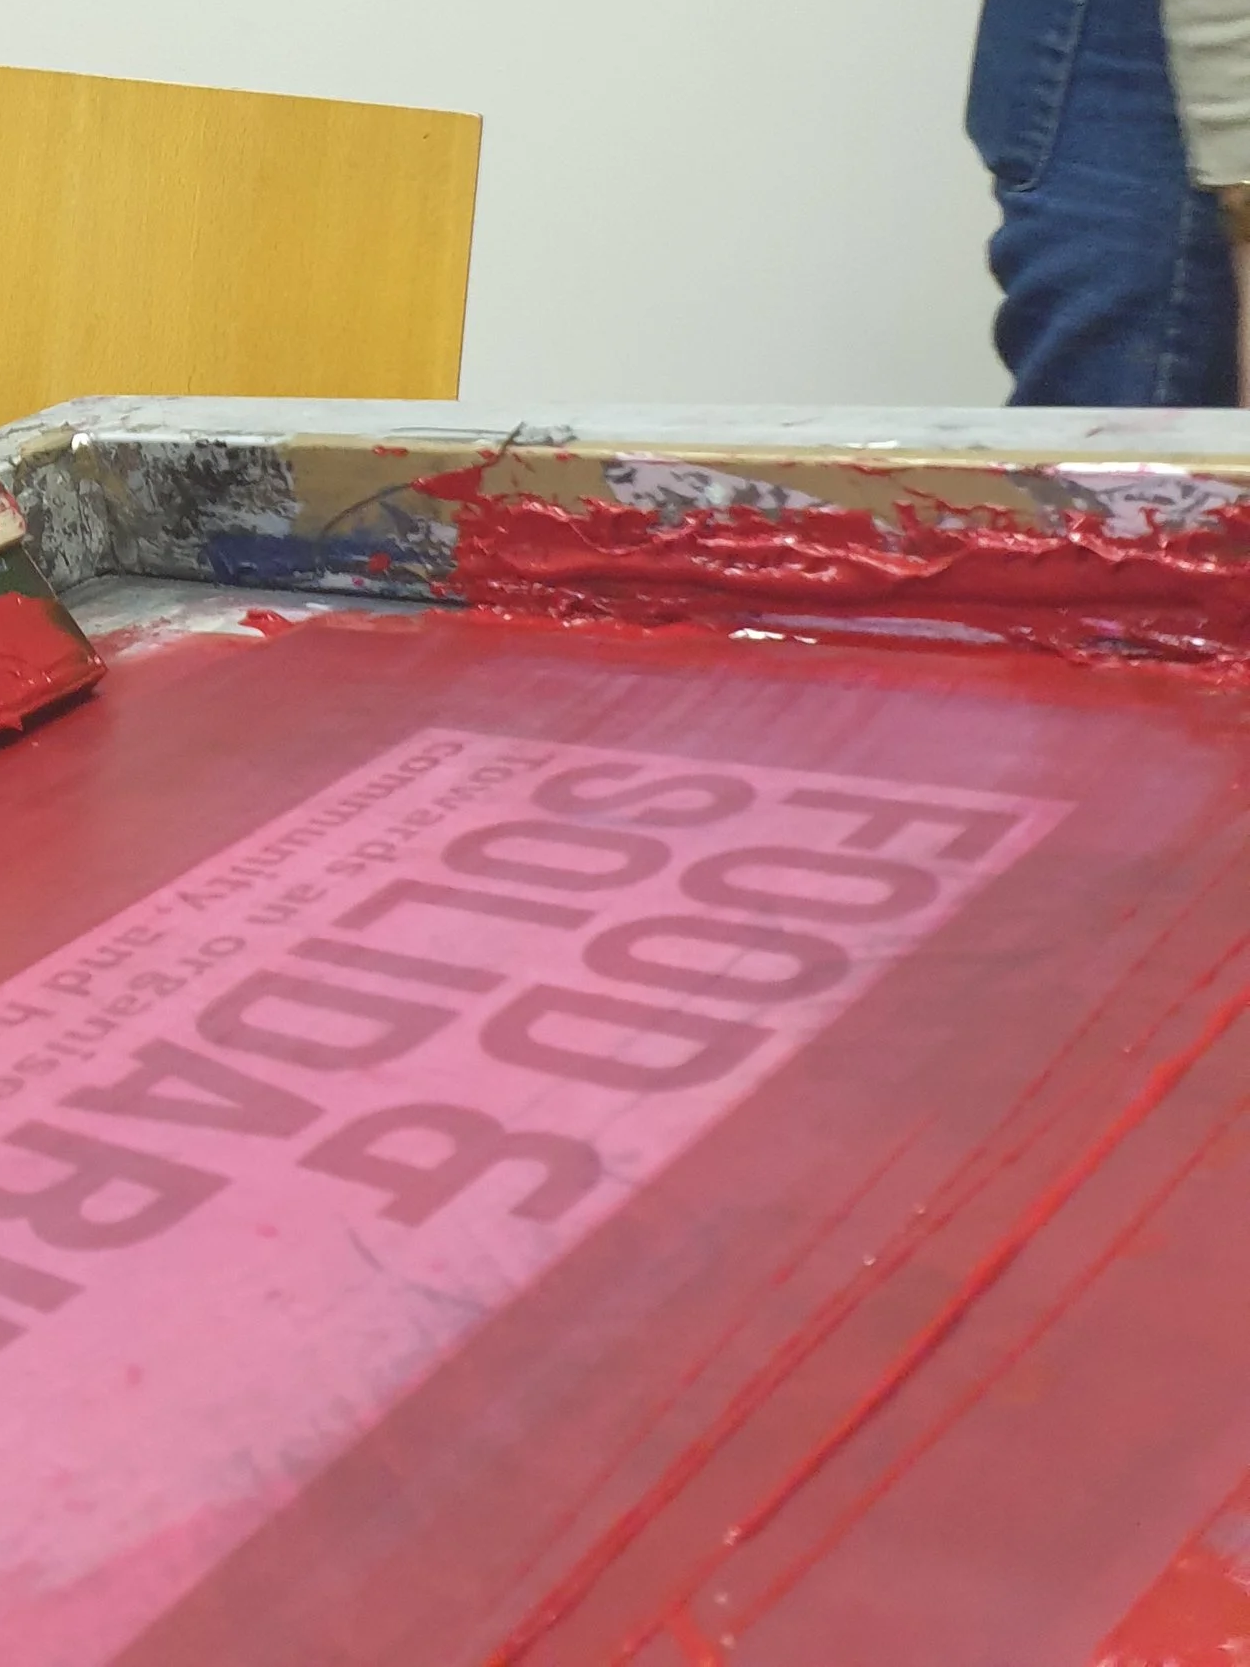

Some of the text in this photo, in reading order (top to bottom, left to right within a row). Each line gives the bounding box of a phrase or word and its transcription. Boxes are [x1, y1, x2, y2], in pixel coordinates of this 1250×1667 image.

[156, 740, 466, 917] community,
[325, 750, 558, 879] Towards
[45, 921, 168, 998] and
[244, 880, 330, 927] an
[296, 787, 1022, 1228] FOOD &
